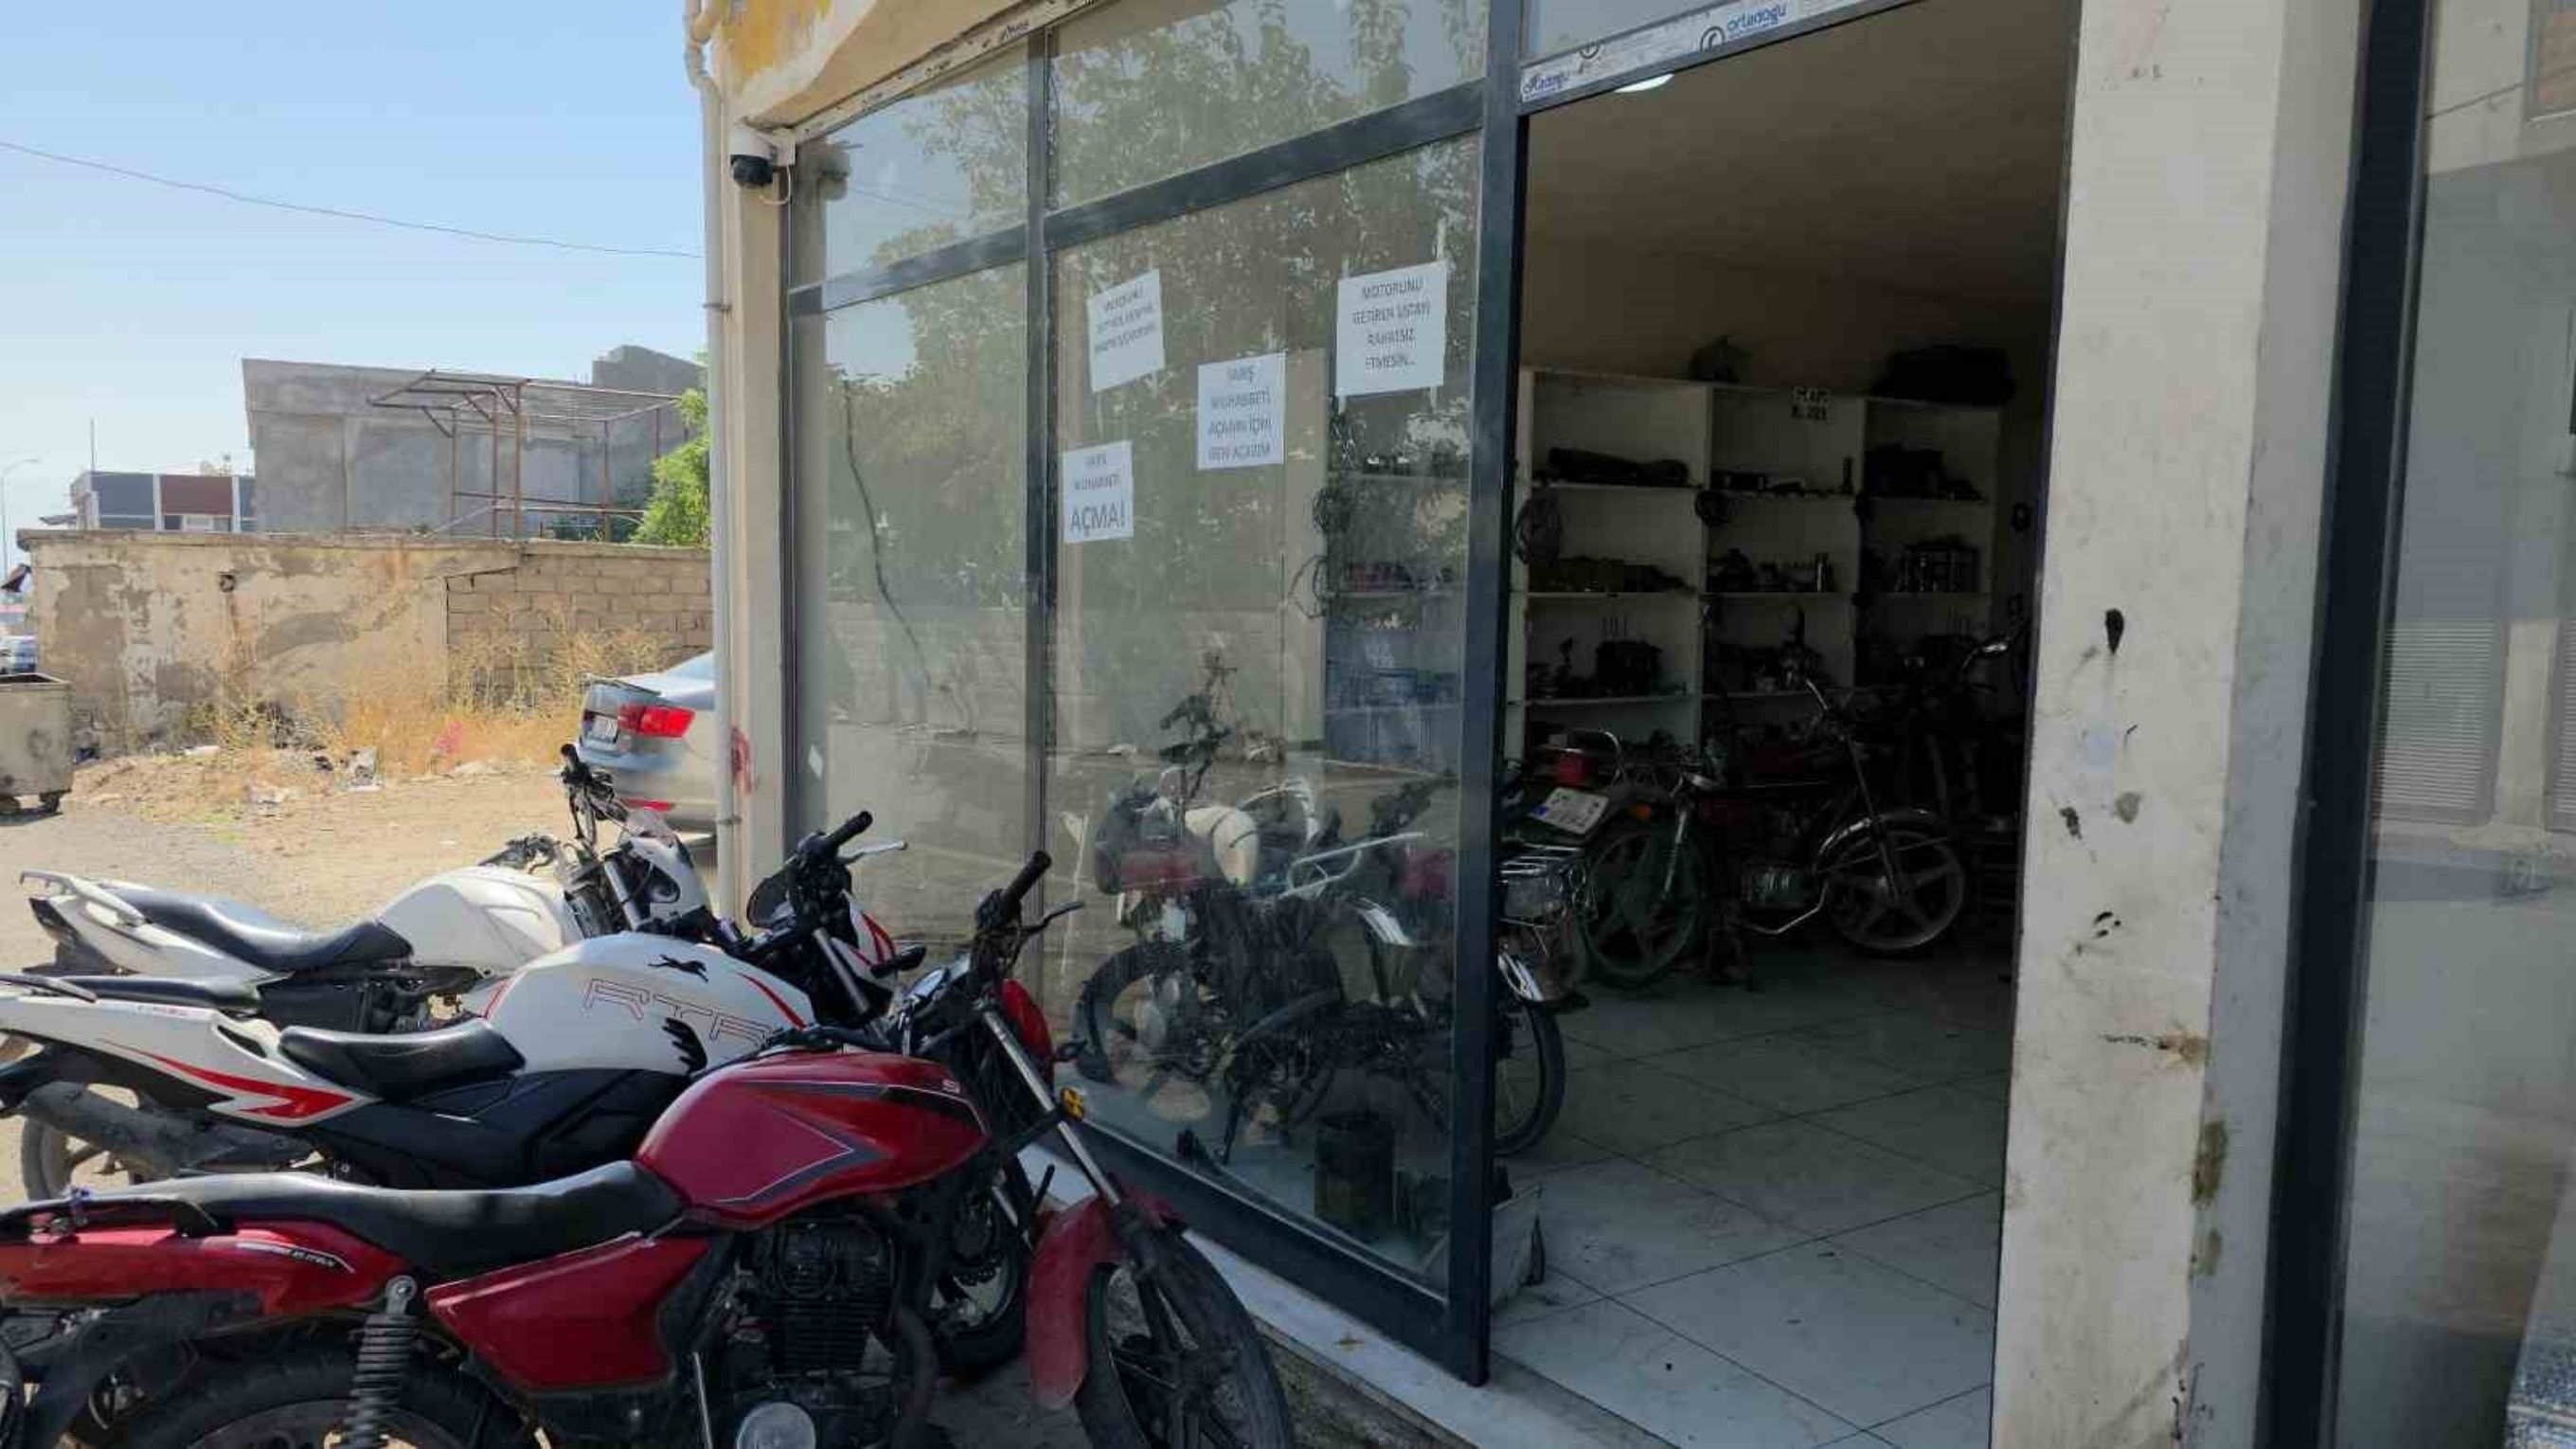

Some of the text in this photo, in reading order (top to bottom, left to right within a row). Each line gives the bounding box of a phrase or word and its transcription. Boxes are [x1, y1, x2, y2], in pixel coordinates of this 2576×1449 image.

[1362, 277, 1422, 298] MOTORUNU
[1070, 499, 1125, 537] AÇMA!
[583, 977, 773, 1046] RTR
